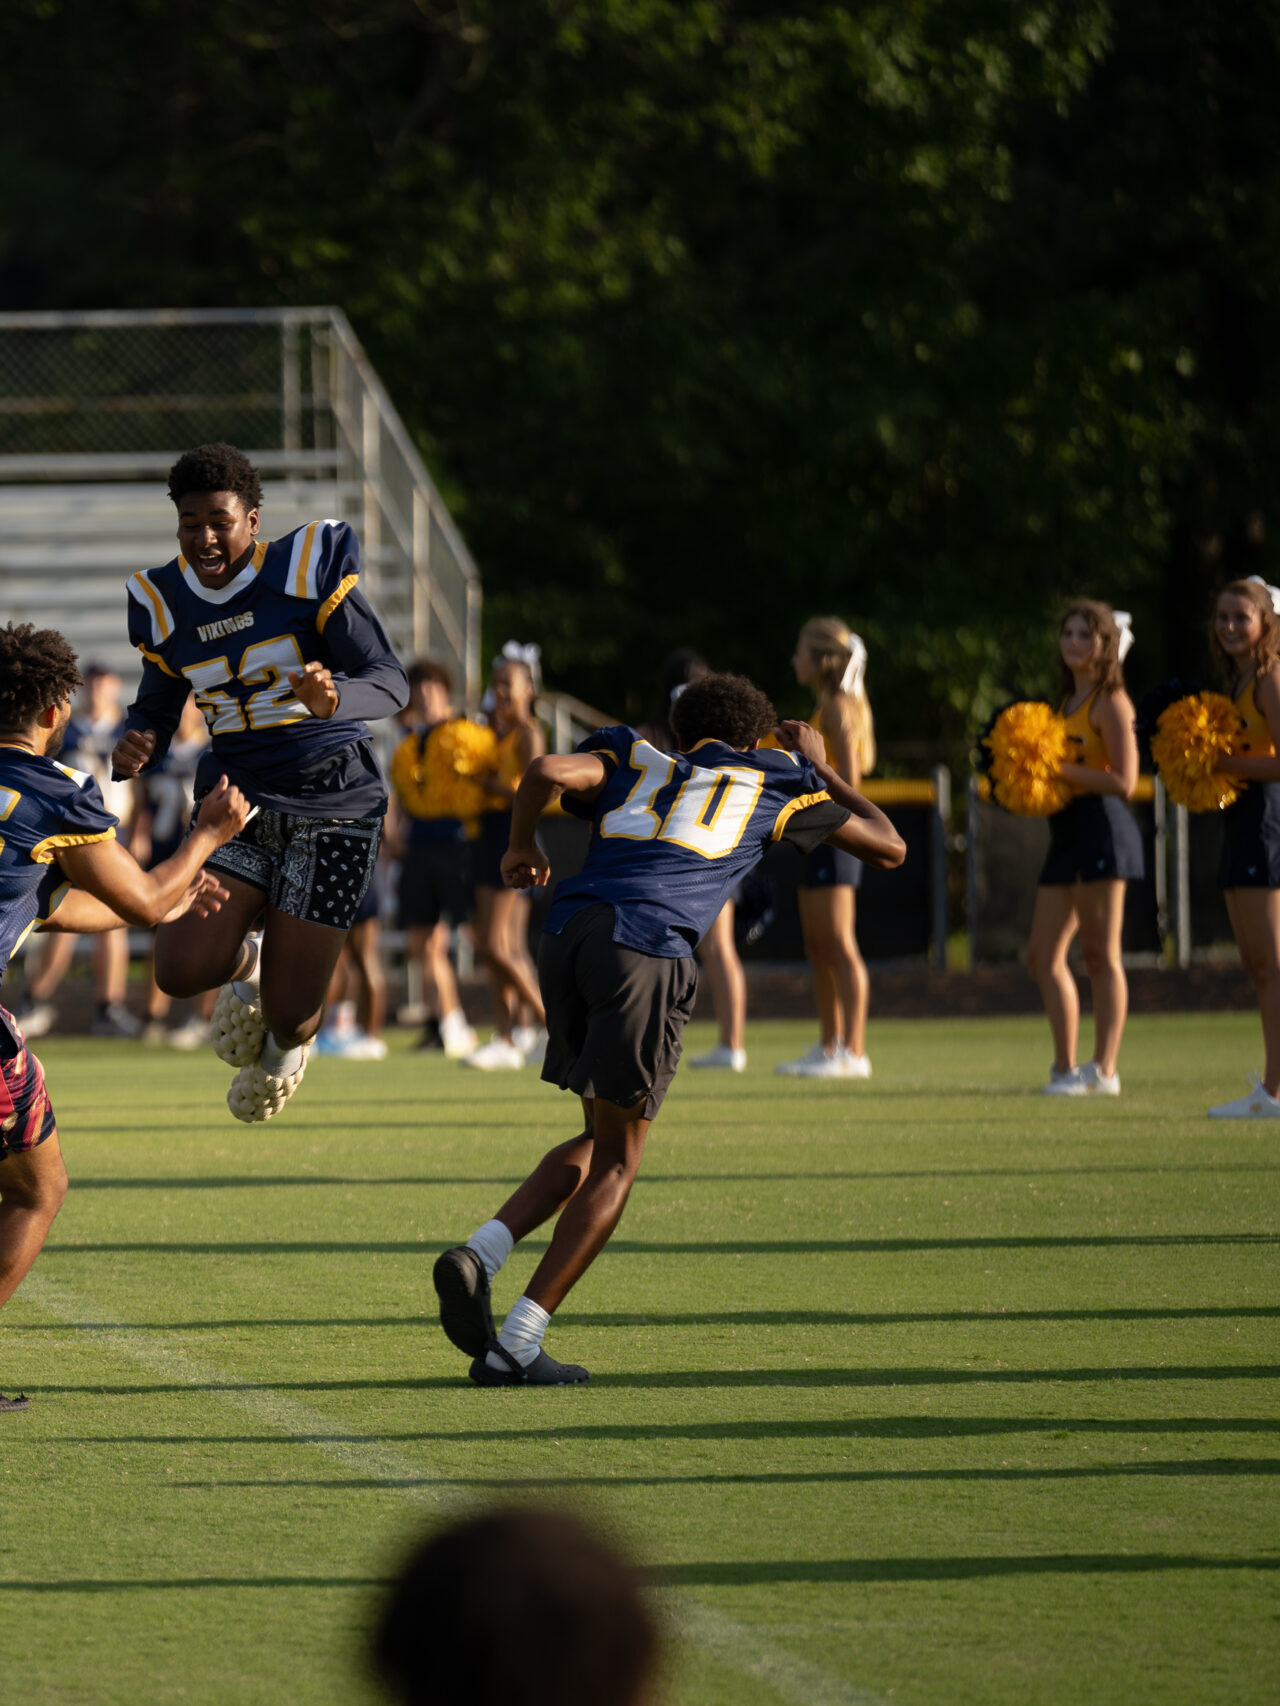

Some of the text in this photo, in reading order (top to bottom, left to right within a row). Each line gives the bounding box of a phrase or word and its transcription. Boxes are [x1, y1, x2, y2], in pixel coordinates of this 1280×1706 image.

[196, 611, 255, 642] VIKINGS
[181, 633, 317, 735] 52
[600, 739, 765, 860] 10
